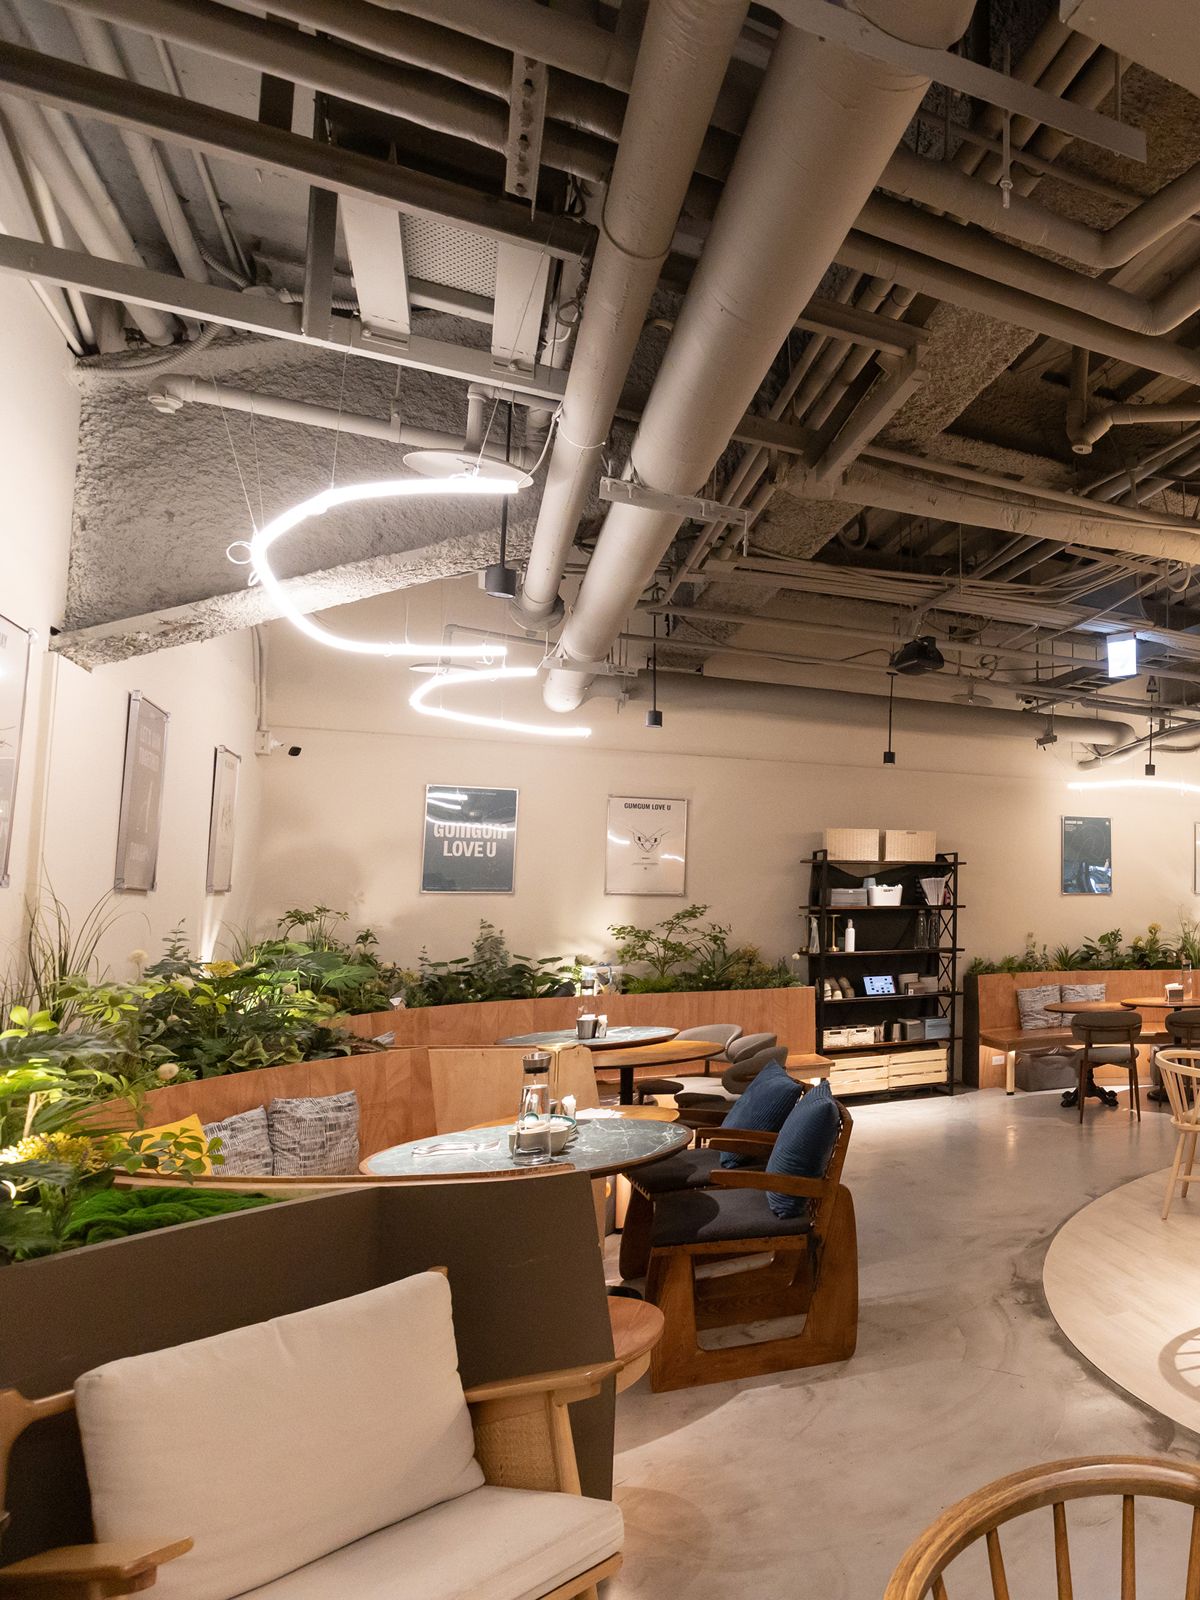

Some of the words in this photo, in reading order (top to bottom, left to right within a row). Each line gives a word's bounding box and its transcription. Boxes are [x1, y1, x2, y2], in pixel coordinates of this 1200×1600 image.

[651, 803, 666, 811] LOVE
[443, 840, 484, 857] LOVE
[486, 841, 497, 858] U
